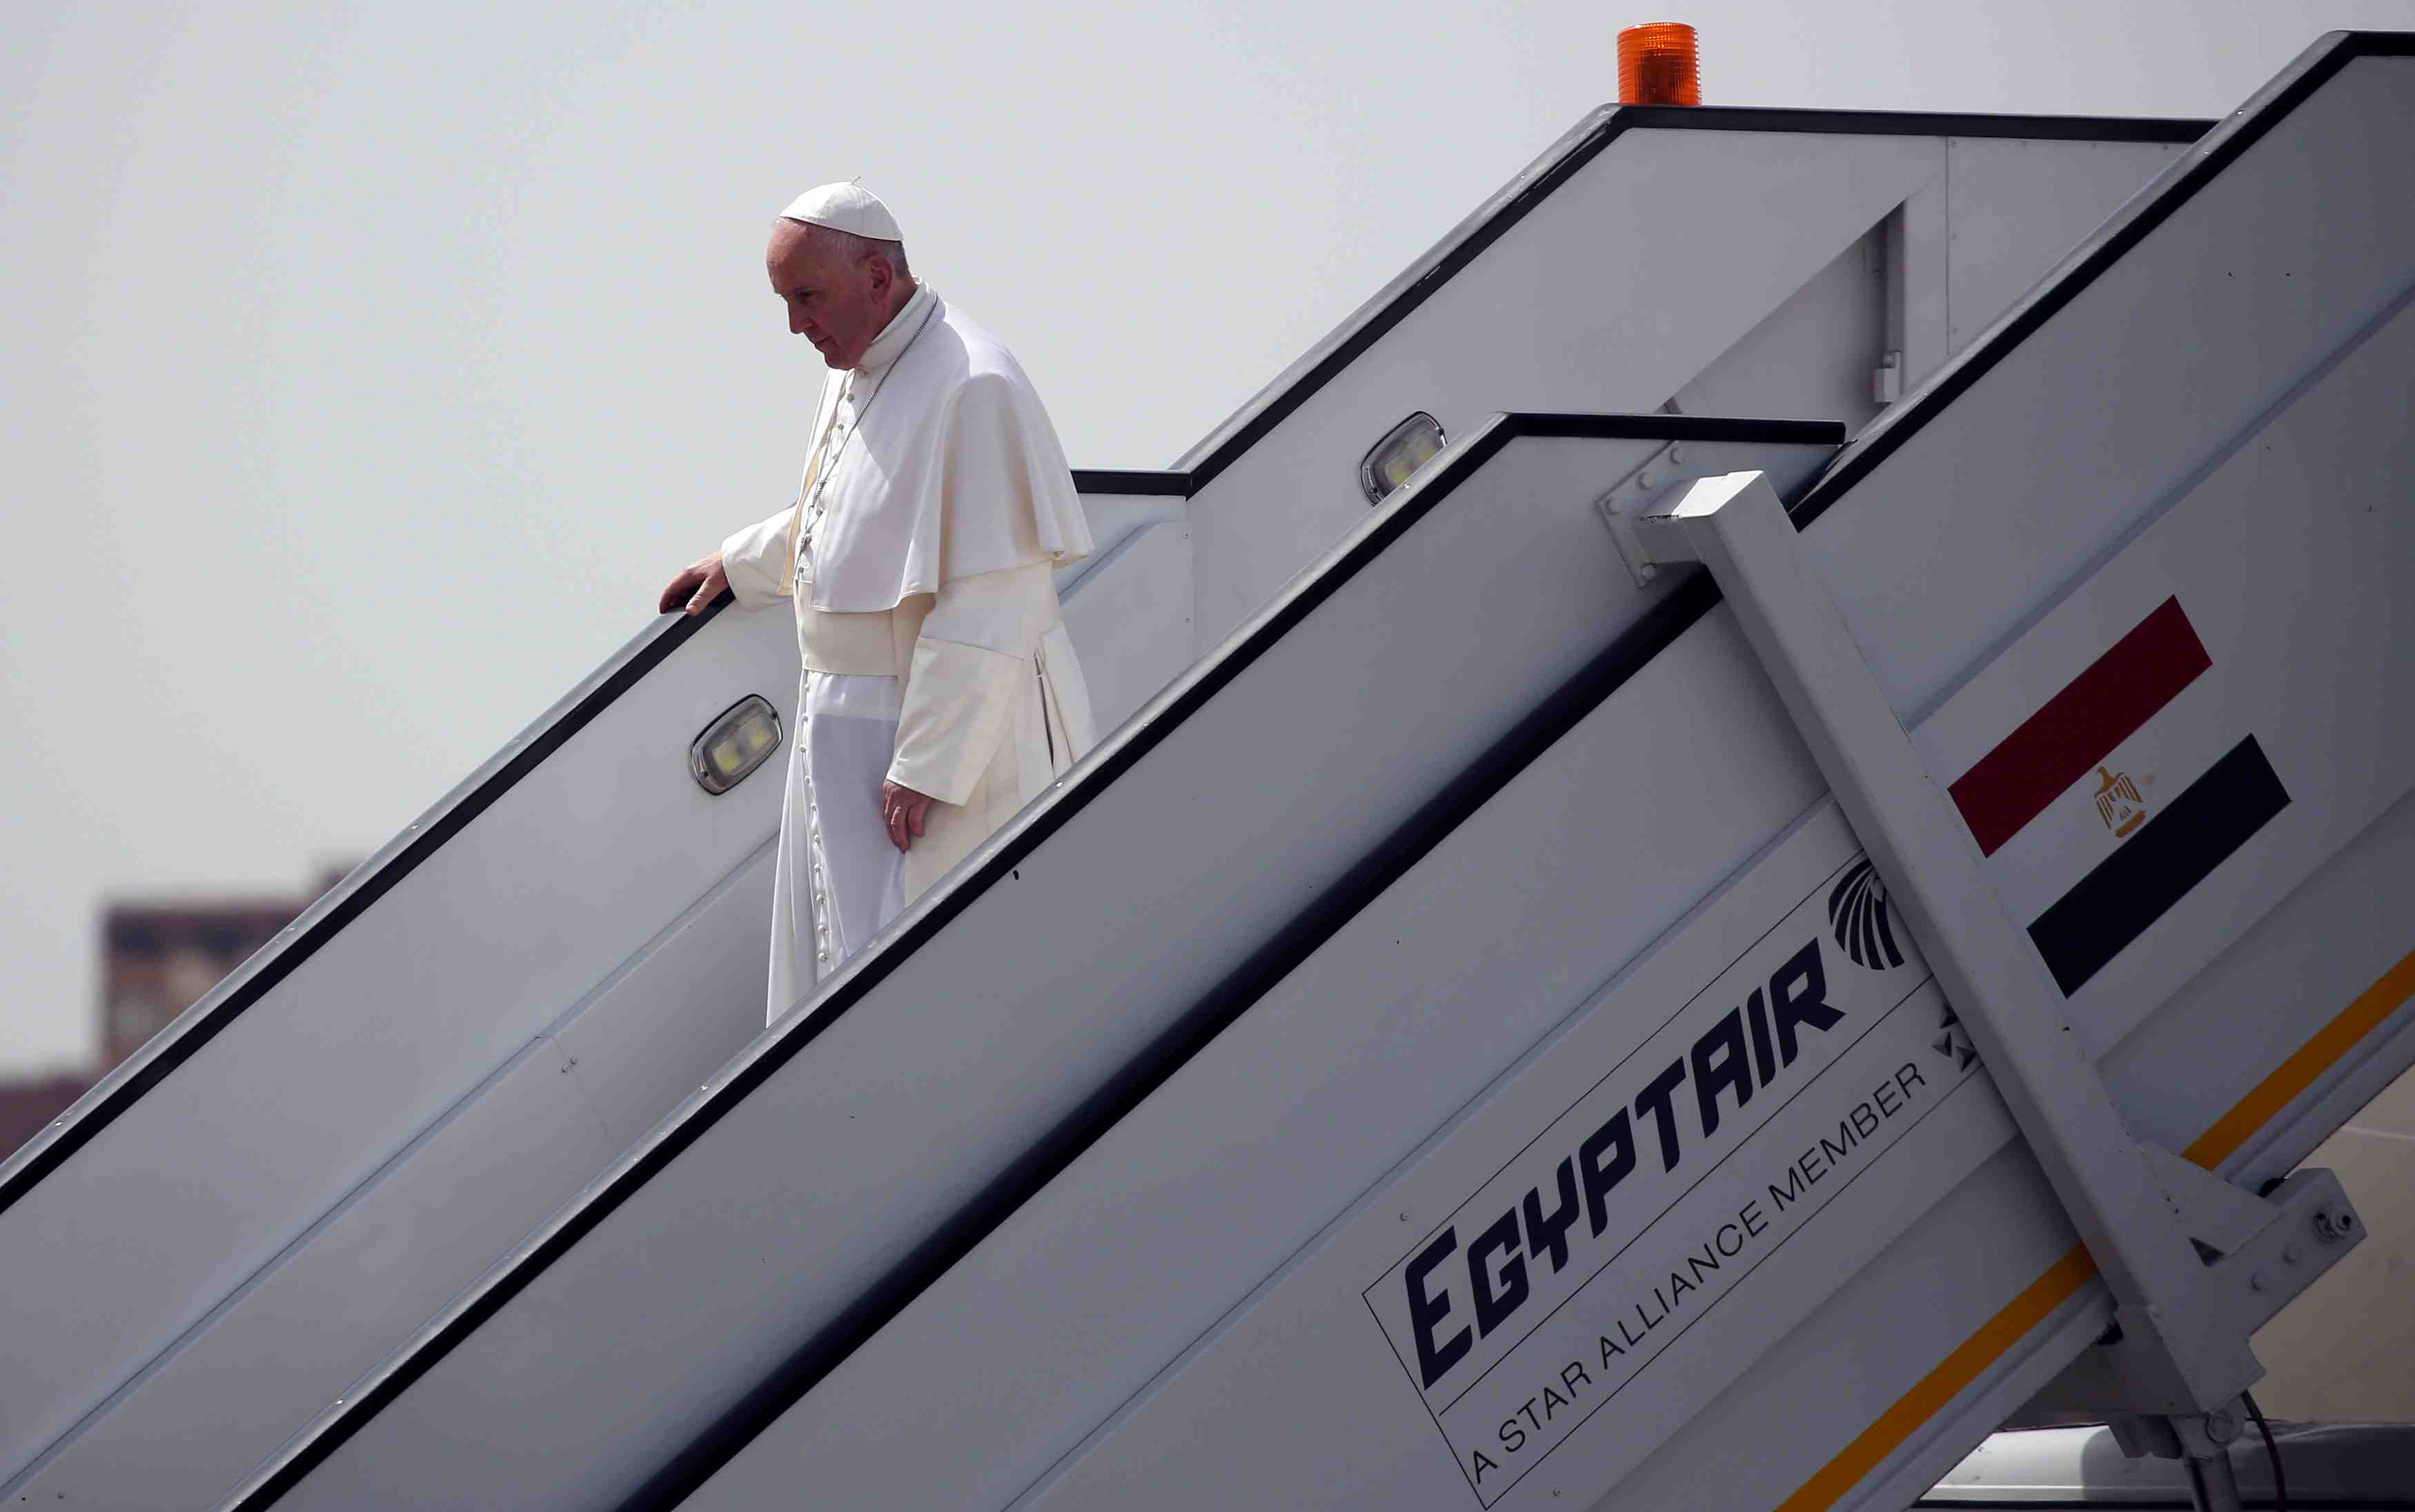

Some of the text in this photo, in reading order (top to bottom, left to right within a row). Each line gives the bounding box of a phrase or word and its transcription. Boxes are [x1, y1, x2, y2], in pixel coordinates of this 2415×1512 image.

[1404, 936, 1846, 1391] EGYPTAIR
[1472, 1062, 1926, 1485] A STAR ALLIANCE MEMBER
